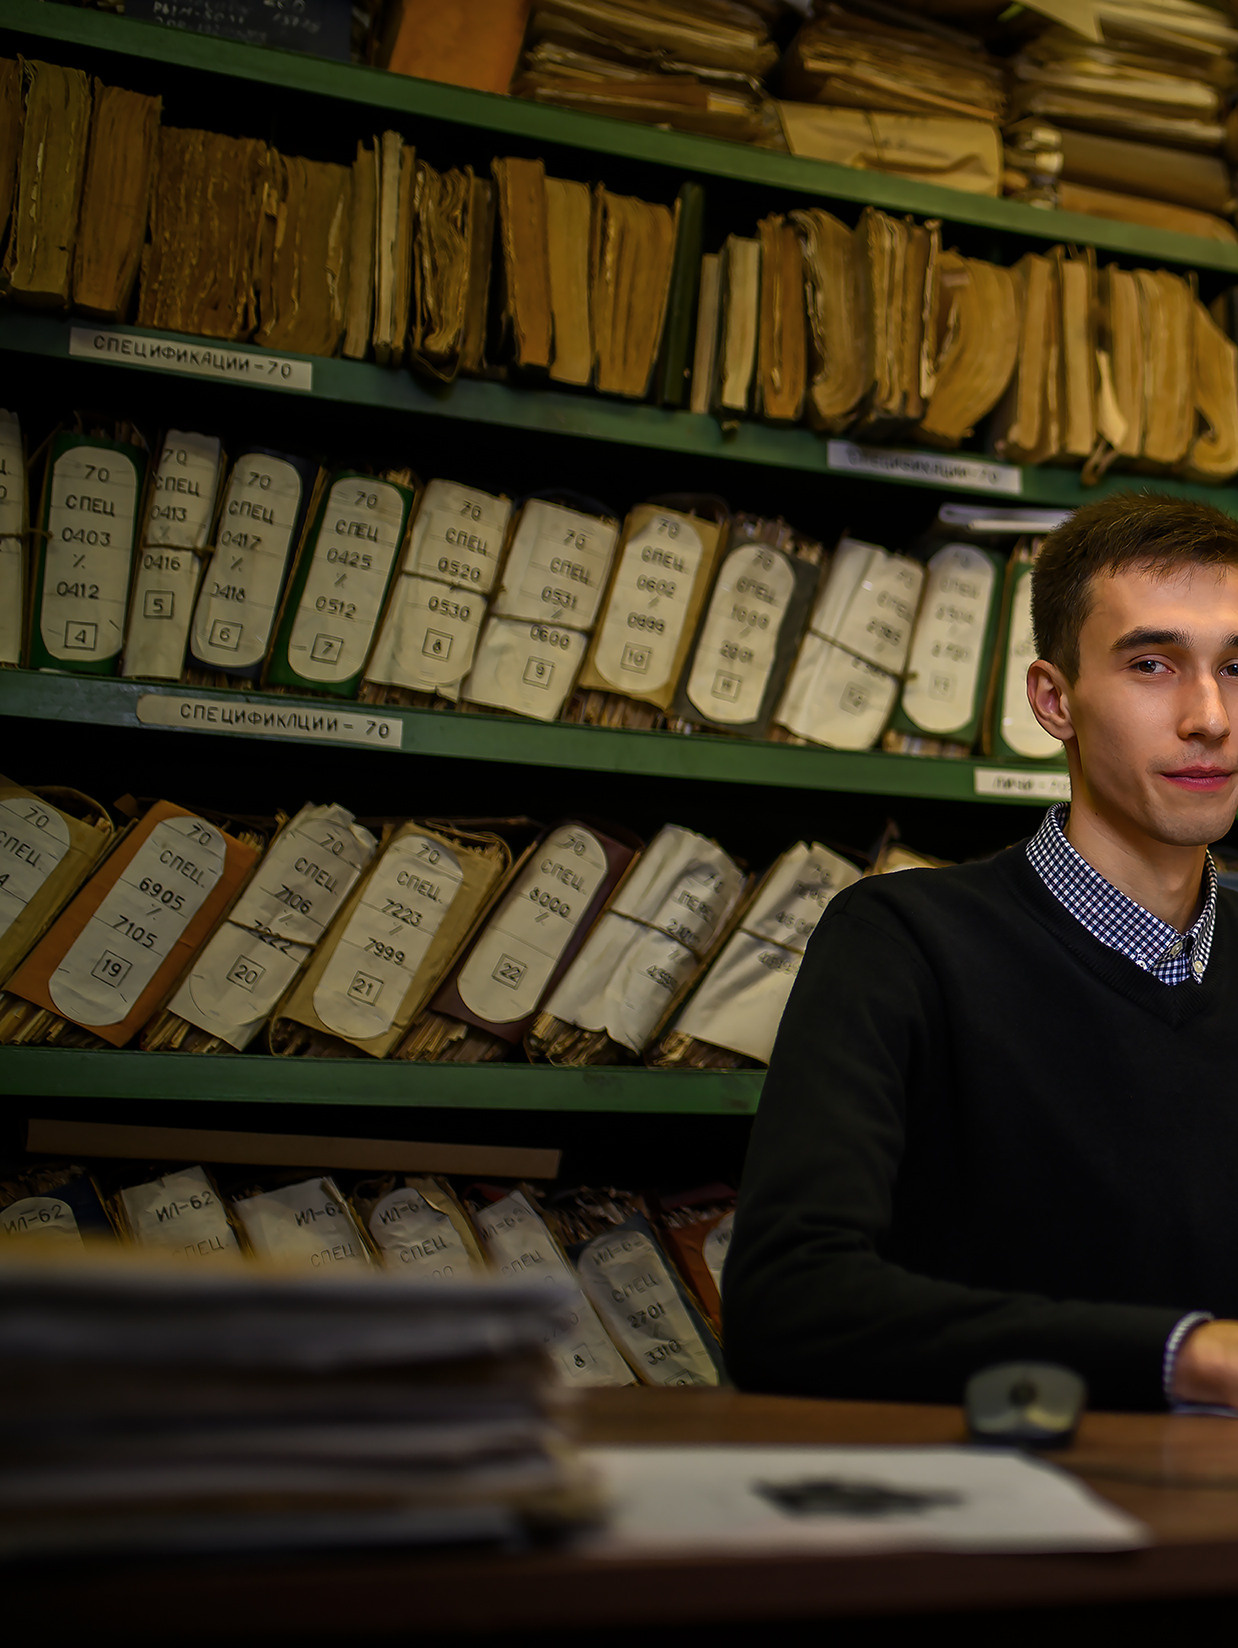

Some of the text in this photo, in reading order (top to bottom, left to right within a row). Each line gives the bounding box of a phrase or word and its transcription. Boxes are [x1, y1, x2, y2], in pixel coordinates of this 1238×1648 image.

[162, 448, 188, 466] 70
[84, 464, 110, 482] 70
[247, 472, 272, 490] 70
[153, 474, 200, 497] СПЕЦ
[65, 494, 115, 517] СПЕЦ
[354, 491, 379, 509] 70
[459, 500, 482, 521] 70
[150, 504, 188, 522] 0413
[228, 500, 274, 525] СПЕЦ
[61, 527, 111, 546] 0403
[221, 531, 262, 549] 0417
[335, 519, 379, 543] СПЕЦ
[445, 527, 489, 556] СПЕЦ
[143, 554, 181, 571] 0416
[327, 548, 373, 569] 0425
[437, 557, 481, 583] 0520
[550, 557, 591, 584] СПЕЦ
[57, 582, 99, 599] 0412
[153, 598, 164, 612] 5
[315, 596, 357, 618] 0512
[428, 596, 471, 621] 0530
[75, 629, 87, 644] 4
[218, 627, 230, 642] 6
[321, 641, 334, 656] 7
[23, 806, 50, 829] 70
[186, 823, 212, 847] 70
[319, 833, 345, 856] 70
[559, 834, 586, 857] 70
[415, 843, 441, 866] 70
[138, 877, 186, 911] 6905
[274, 884, 313, 915] 7106
[529, 886, 570, 918] 8000
[380, 898, 423, 928] 7223
[112, 915, 158, 949] 7105
[363, 937, 406, 967] 7999
[101, 957, 122, 978] 19
[234, 964, 258, 985] 20
[499, 962, 521, 982] 22
[351, 978, 374, 997] 21
[156, 1190, 215, 1222] ИЛ-62
[3, 1204, 65, 1234] ИЛ-62
